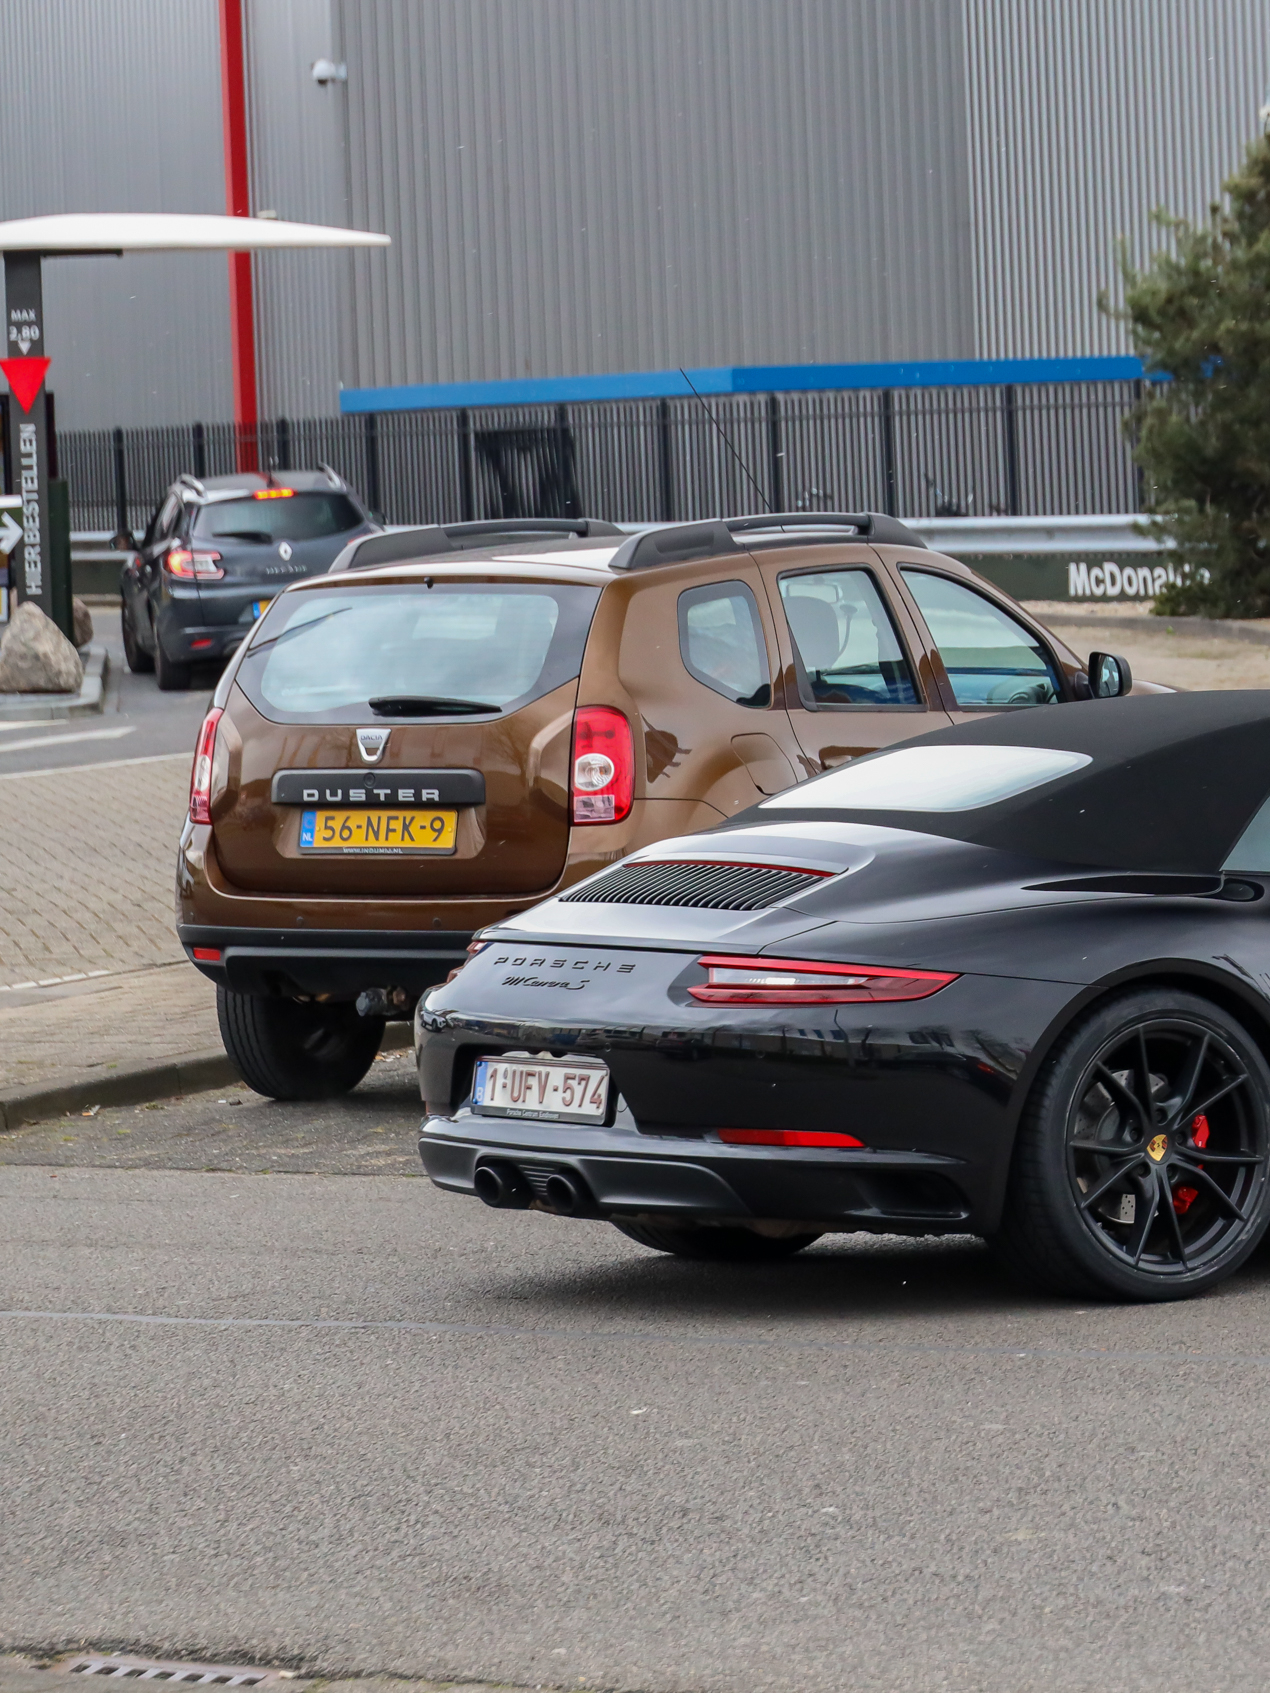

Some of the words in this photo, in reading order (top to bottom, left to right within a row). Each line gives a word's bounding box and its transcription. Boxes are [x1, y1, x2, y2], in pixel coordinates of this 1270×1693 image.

[11, 308, 36, 322] MAX
[1068, 561, 1211, 597] McDonal
[302, 788, 440, 802] DUSTER
[302, 832, 313, 841] NL
[322, 815, 446, 842] 56-NFK-9
[494, 956, 636, 973] PORSCHE
